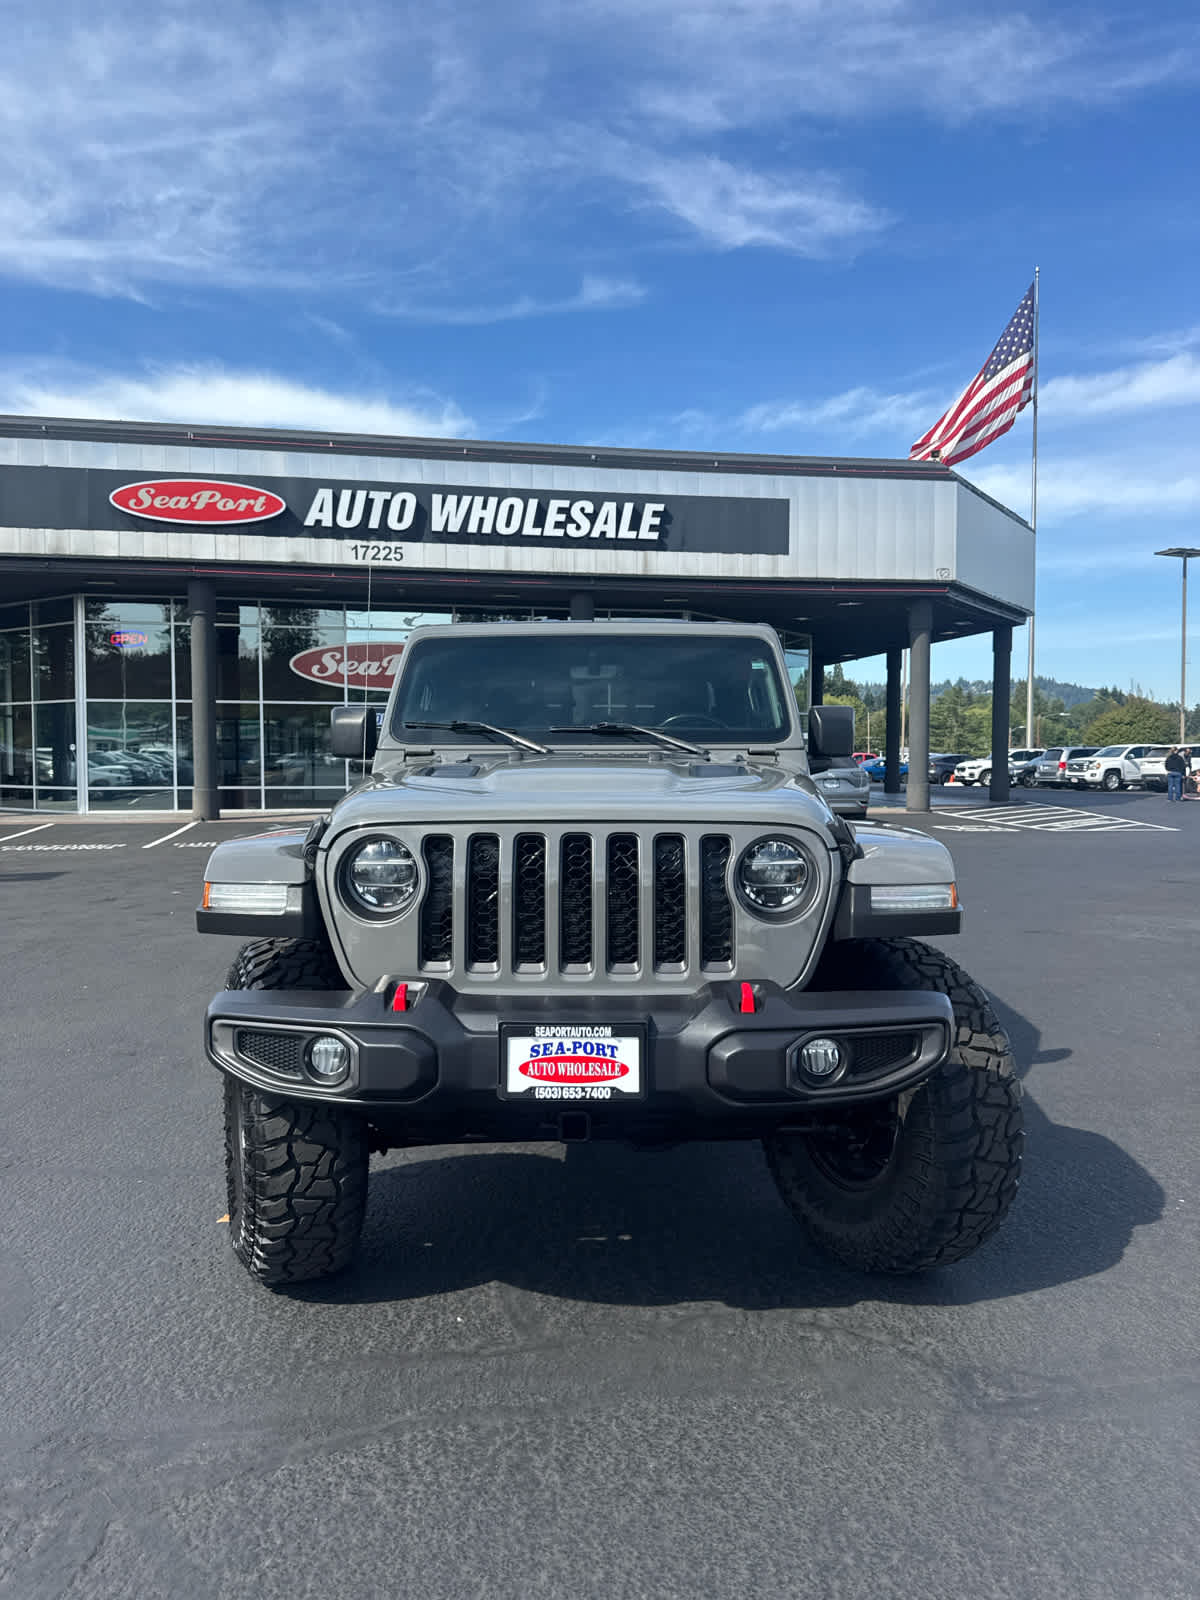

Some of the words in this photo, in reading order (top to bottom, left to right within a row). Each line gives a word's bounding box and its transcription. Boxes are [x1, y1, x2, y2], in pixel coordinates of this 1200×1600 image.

[128, 487, 267, 512] SeaPort
[304, 488, 416, 531] AUTO
[430, 493, 665, 541] WHOLESALE
[351, 544, 404, 561] 17225
[110, 633, 148, 645] OPEN
[535, 1026, 612, 1037] SEAPORTAUTO.COM
[529, 1041, 619, 1058] SEA-PORT
[527, 1062, 556, 1077] AUTO
[558, 1062, 622, 1077] WHOLESALE
[535, 1087, 562, 1099] (503)
[563, 1087, 611, 1099] 653-7400
